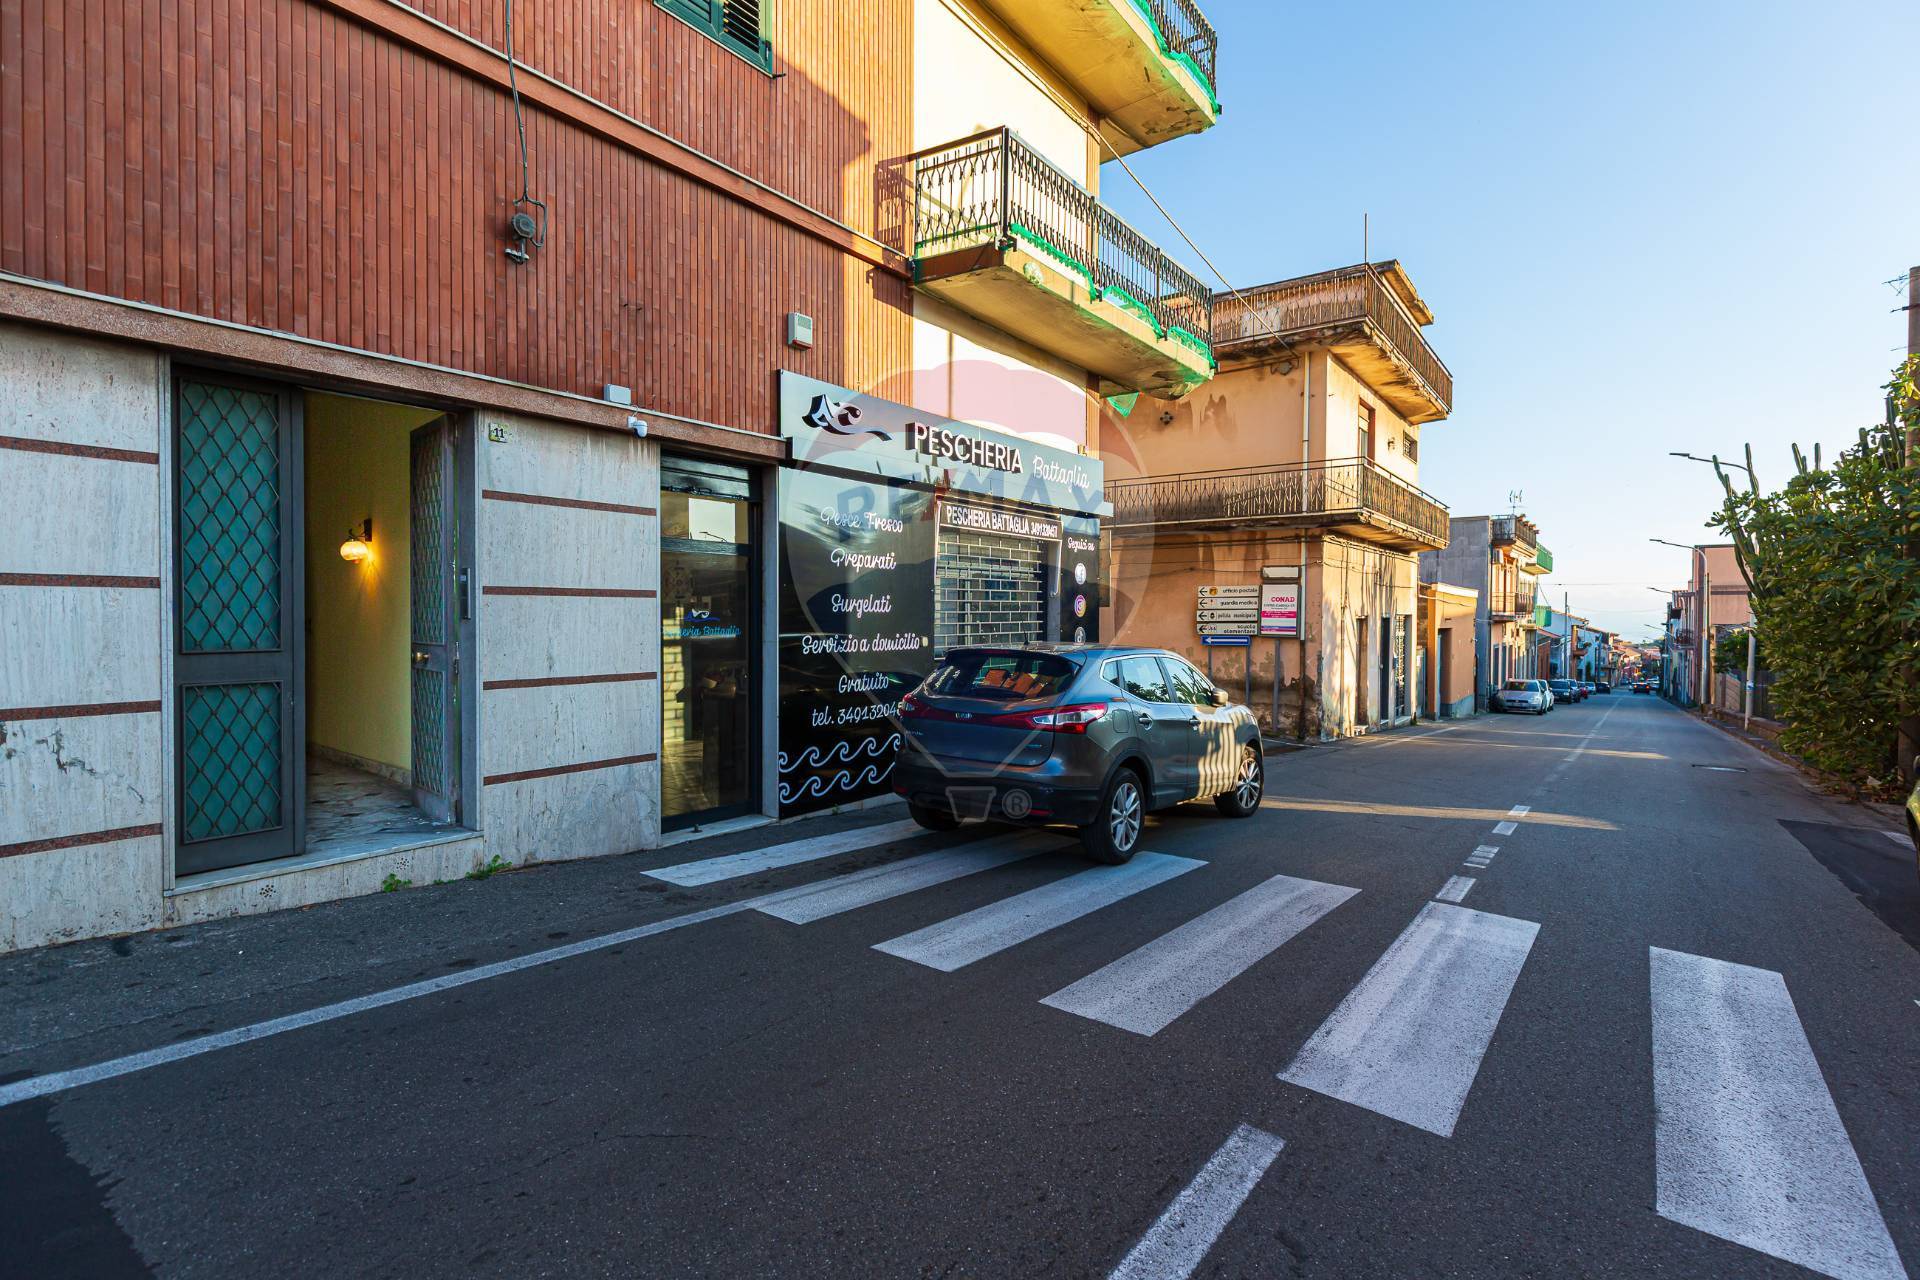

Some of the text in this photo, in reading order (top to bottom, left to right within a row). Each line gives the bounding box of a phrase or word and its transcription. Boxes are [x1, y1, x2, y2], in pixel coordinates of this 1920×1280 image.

[494, 427, 504, 438] 11
[913, 421, 1091, 493] PESCHERIA Battaglia
[820, 506, 904, 533] Pesce Fresco
[946, 505, 992, 530] PESCHERIA
[991, 512, 1030, 536] BATTAGLIA
[830, 547, 897, 573] Preparati
[831, 593, 892, 619] Surgelati
[801, 634, 859, 655] Servizio
[871, 632, 920, 652] domicilio
[838, 672, 889, 694] Gratuito
[812, 705, 835, 727] tel.
